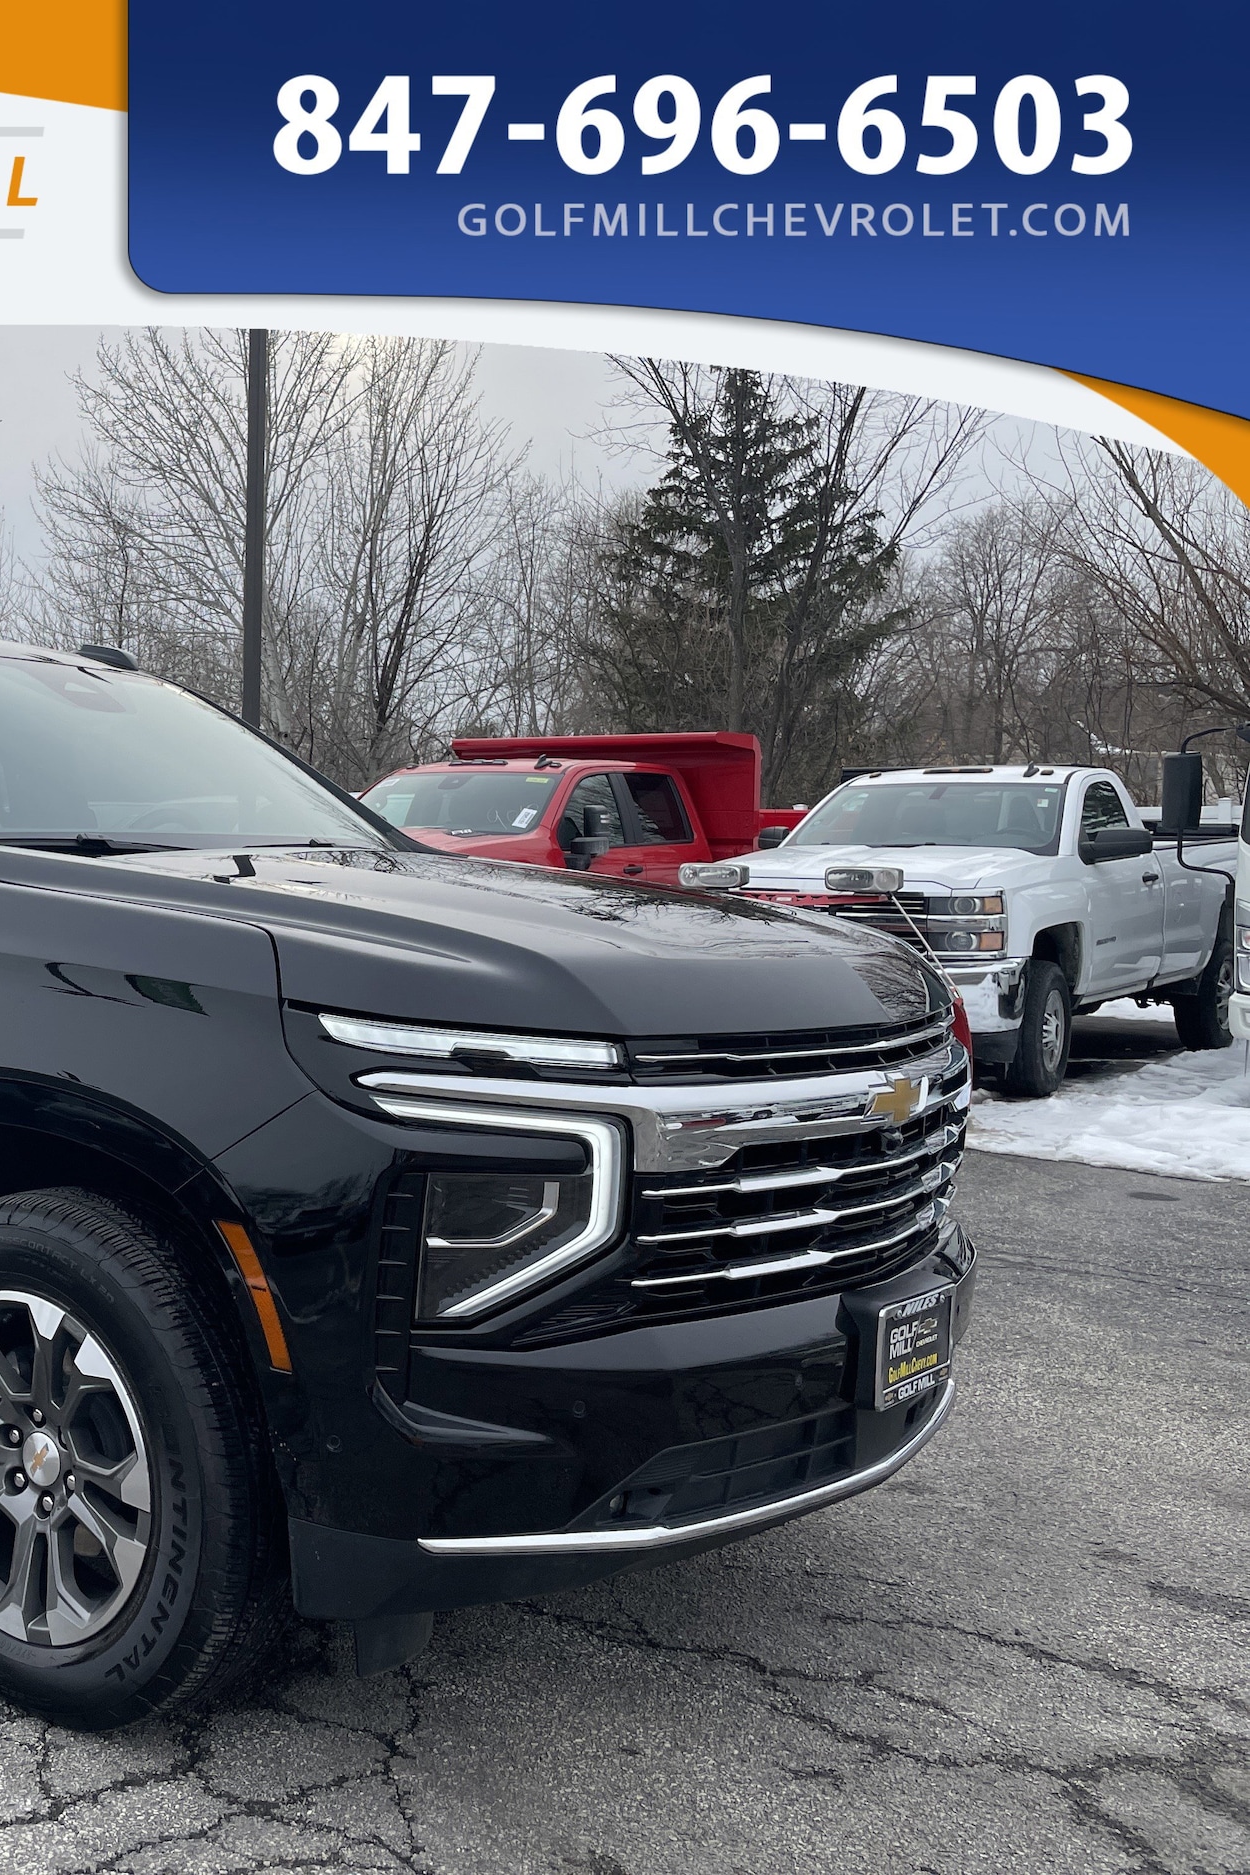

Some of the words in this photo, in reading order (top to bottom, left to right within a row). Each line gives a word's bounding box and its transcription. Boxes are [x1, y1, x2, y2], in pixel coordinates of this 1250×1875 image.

[902, 1293, 940, 1318] NILES
[890, 1320, 919, 1344] GOLF
[890, 1338, 913, 1360] MILL
[898, 1380, 918, 1400] GOLF
[917, 1374, 936, 1392] MILL
